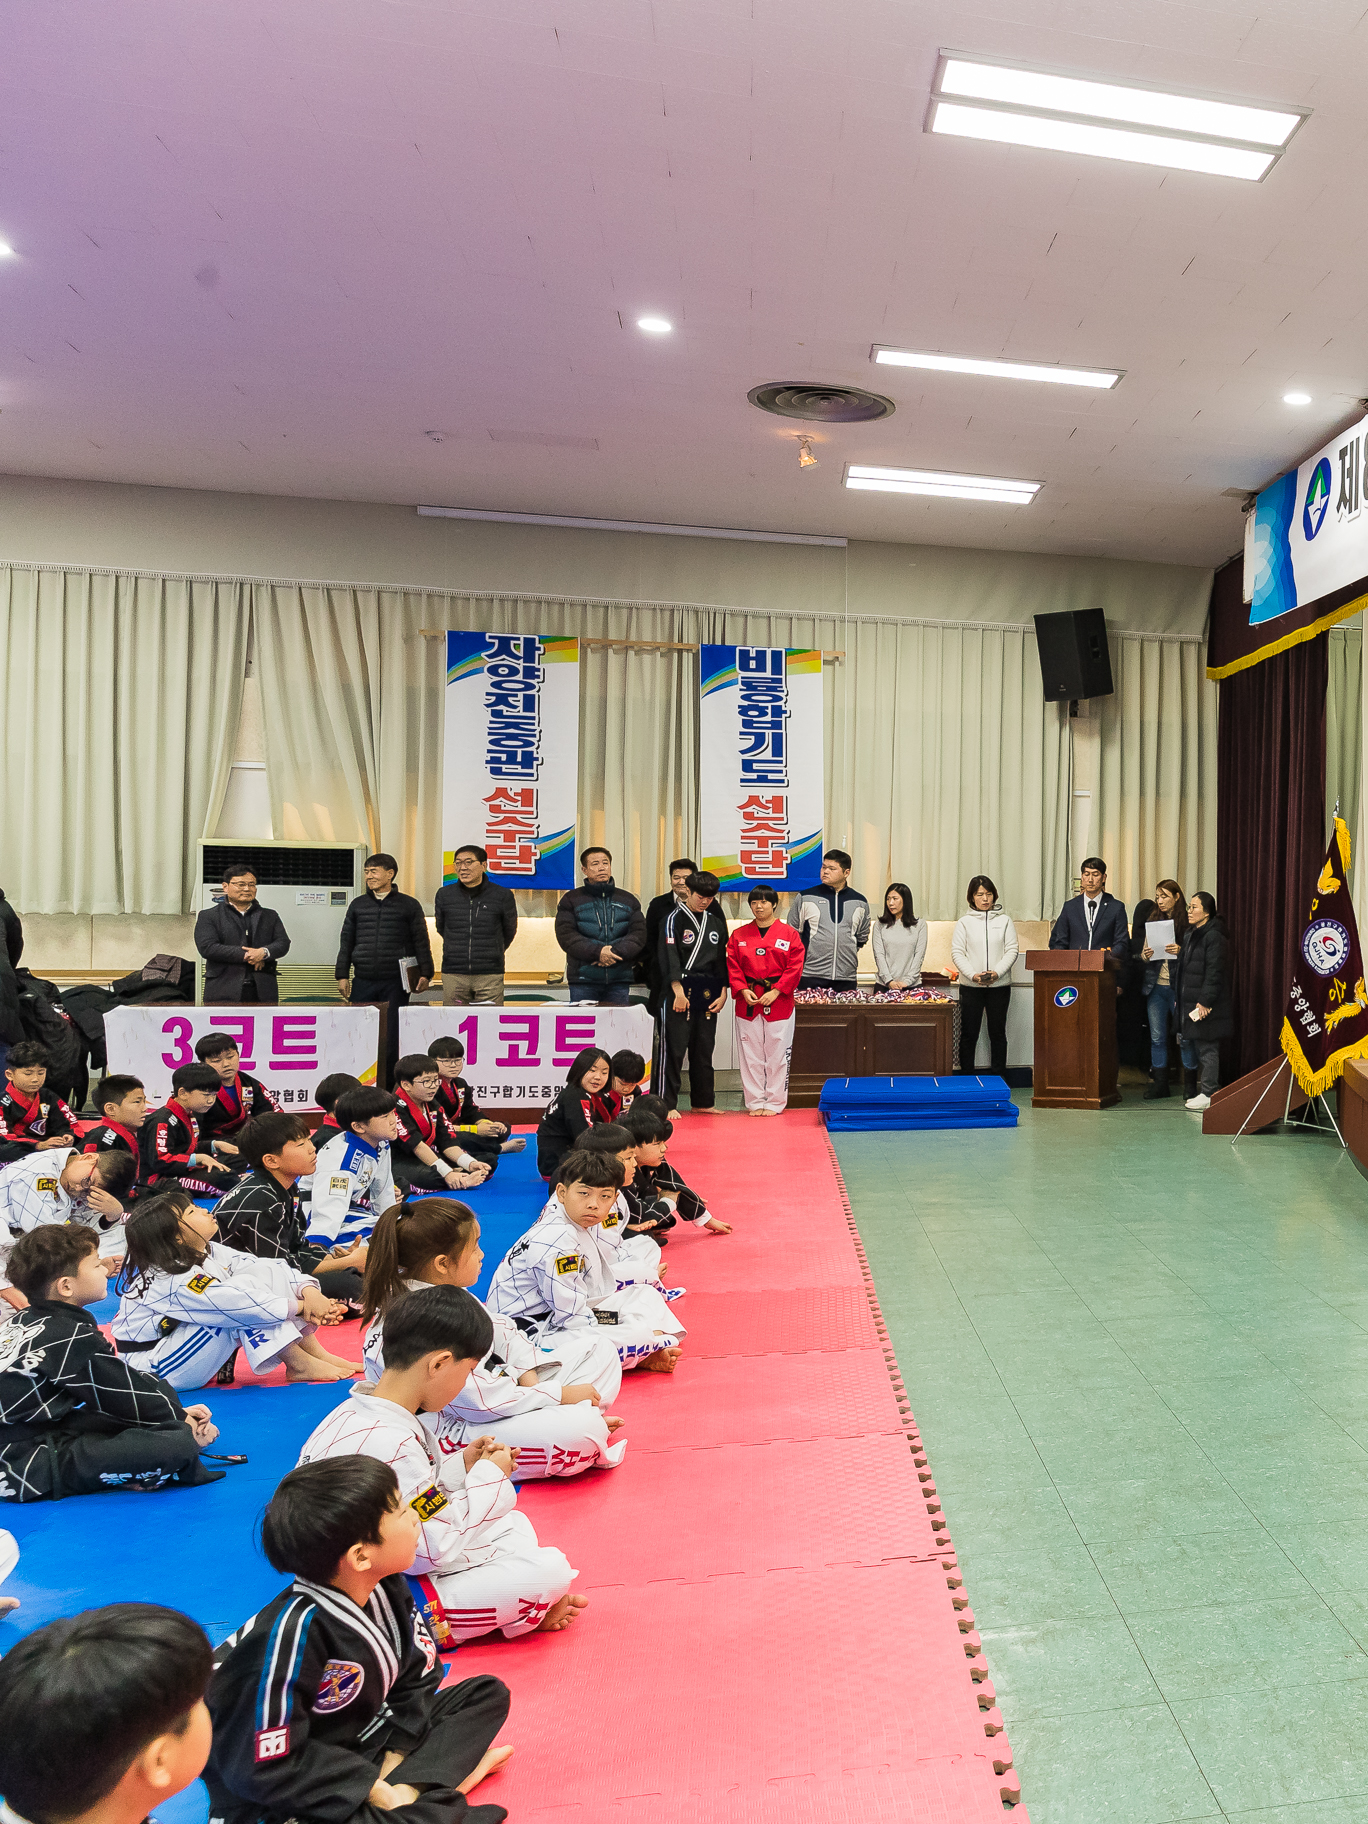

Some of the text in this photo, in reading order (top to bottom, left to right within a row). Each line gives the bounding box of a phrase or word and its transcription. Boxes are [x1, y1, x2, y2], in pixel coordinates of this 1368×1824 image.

[736, 648, 790, 877] 비룡합기도 선수단
[481, 786, 539, 874] 선수단
[458, 1015, 597, 1068] 1코트
